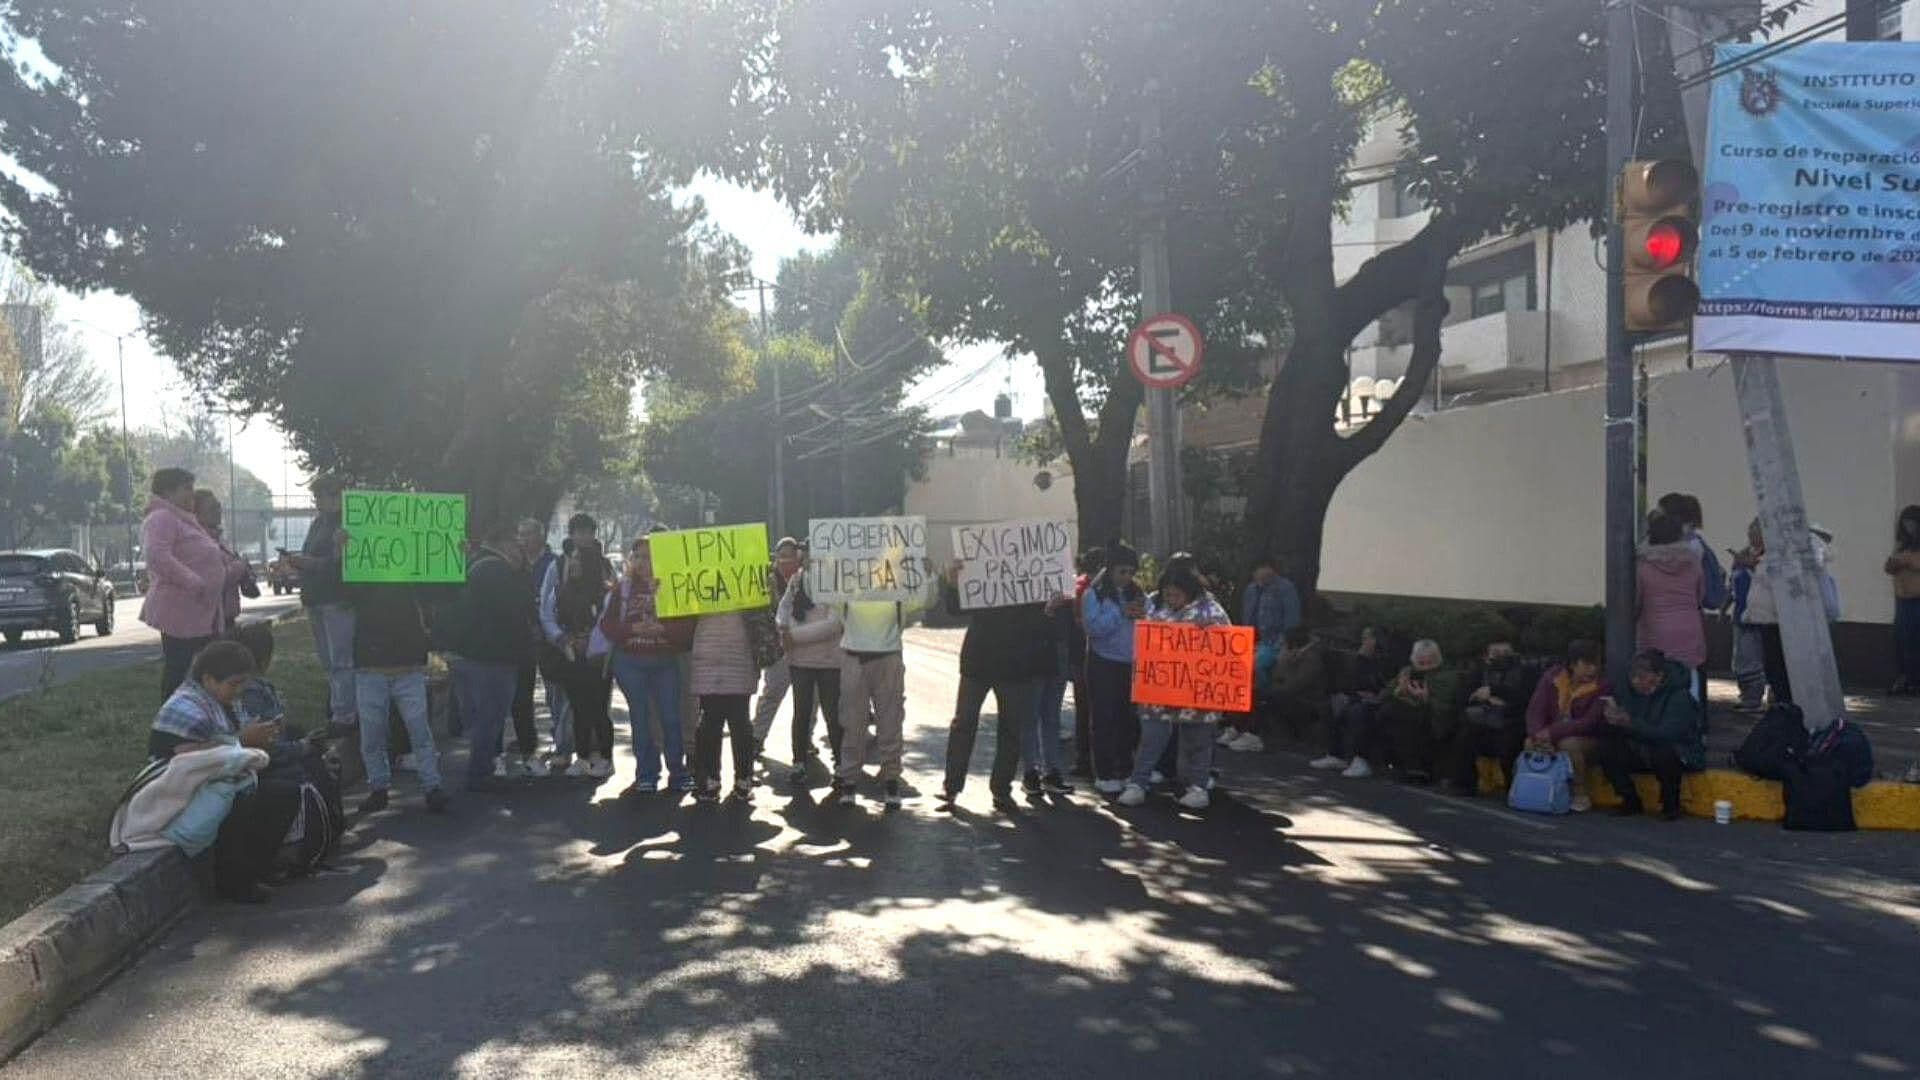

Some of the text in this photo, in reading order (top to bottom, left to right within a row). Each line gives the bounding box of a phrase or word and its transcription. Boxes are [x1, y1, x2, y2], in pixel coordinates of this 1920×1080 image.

[1803, 73, 1915, 88] INSTITUTO
[1803, 99, 1859, 110] Escuela
[1720, 144, 1777, 158] Curso
[1783, 145, 1808, 158] de
[1795, 168, 1872, 190] Nivel
[1713, 200, 1849, 219] Pre-registro
[1857, 206, 1869, 216] e
[1711, 225, 1737, 236] Del
[1741, 223, 1754, 237] 9
[1759, 226, 1779, 237] de
[1785, 225, 1906, 241] noviembre
[1709, 247, 1722, 258] al
[1728, 245, 1740, 259] 5
[1746, 247, 1767, 260] de
[1773, 248, 1856, 263] febrero
[1861, 253, 1884, 263] de
[346, 494, 465, 531] EXIGIMOS
[682, 531, 737, 566] IPN
[812, 522, 926, 552] GOBIERNO
[959, 521, 1067, 561] EXIGIMOS
[344, 530, 464, 576] PAGO IPN
[1137, 623, 1249, 657] TRABAJO
[1135, 659, 1244, 690] HASTA QUE
[1193, 679, 1248, 707] PAGUE
